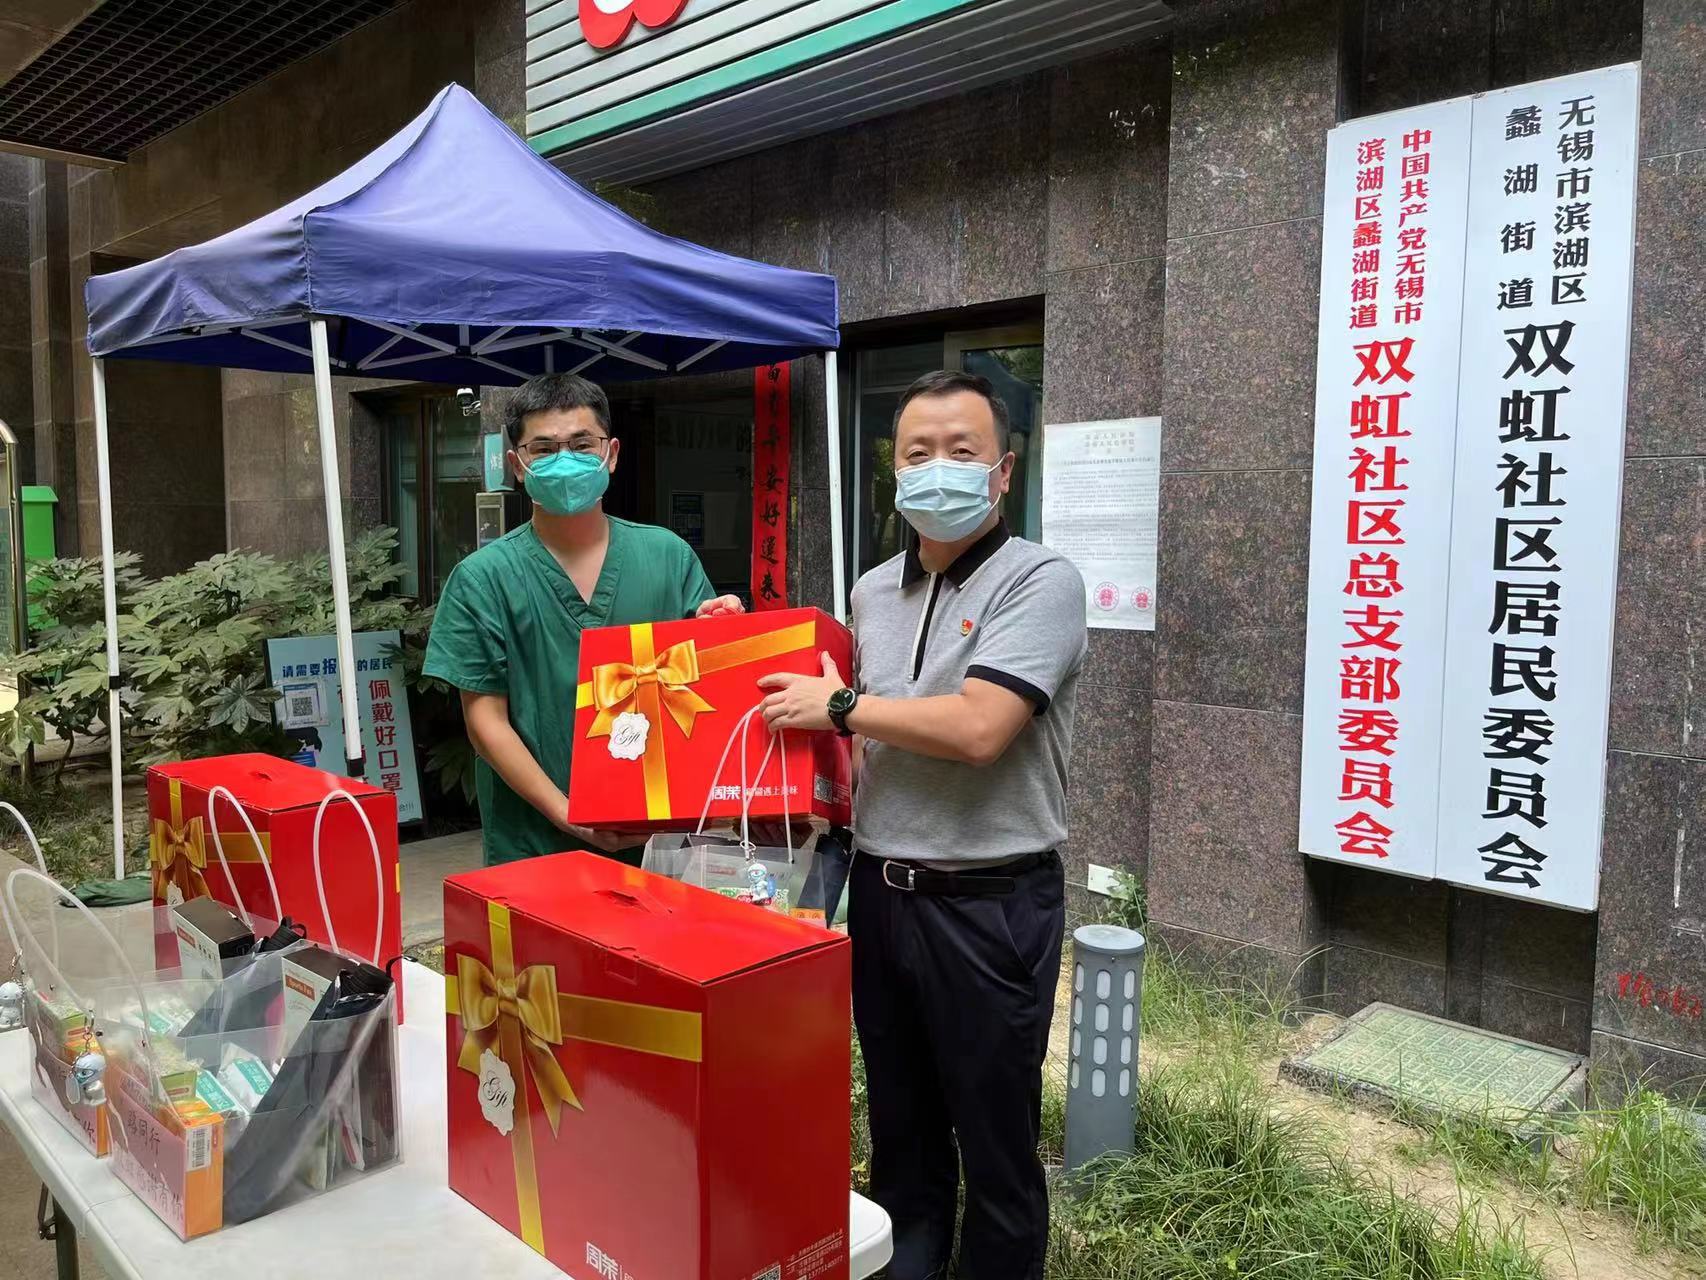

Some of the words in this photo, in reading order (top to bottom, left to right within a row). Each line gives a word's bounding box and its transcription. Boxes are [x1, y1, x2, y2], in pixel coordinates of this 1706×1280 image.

[1349, 138, 1386, 330] 滨湖区蠡湖街道
[1394, 129, 1432, 325] 中国共产党无锡市
[1497, 105, 1542, 311] 蠡湖街道
[1551, 95, 1596, 305] 无锡市滨湖区
[282, 658, 393, 678] 请需要报的居民
[1334, 337, 1416, 858] 双虹社区总支部委员会
[1477, 320, 1576, 889] 双虹社区居民委员会
[368, 679, 403, 793] 佩戴好口罩
